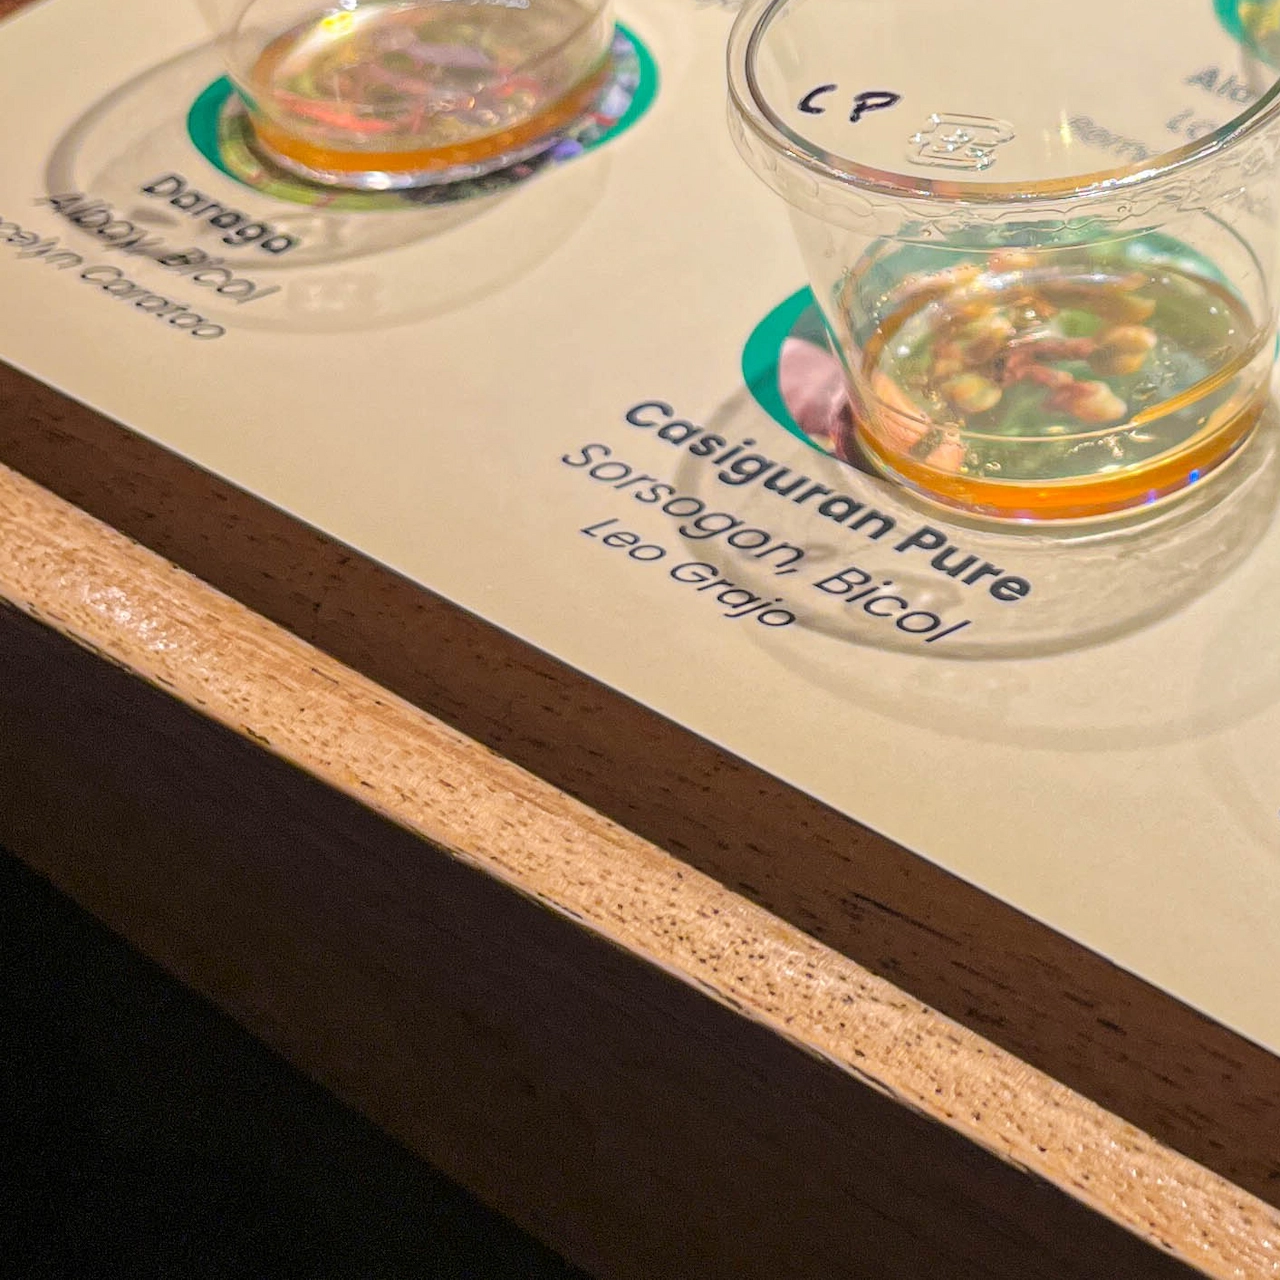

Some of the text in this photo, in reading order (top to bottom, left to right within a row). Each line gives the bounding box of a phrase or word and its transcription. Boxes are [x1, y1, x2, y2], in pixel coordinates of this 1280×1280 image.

[561, 442, 973, 644] Sorsogon, Bicol
[579, 517, 797, 628] Leo Grajo
[625, 399, 1033, 603] Casiguran Pure
